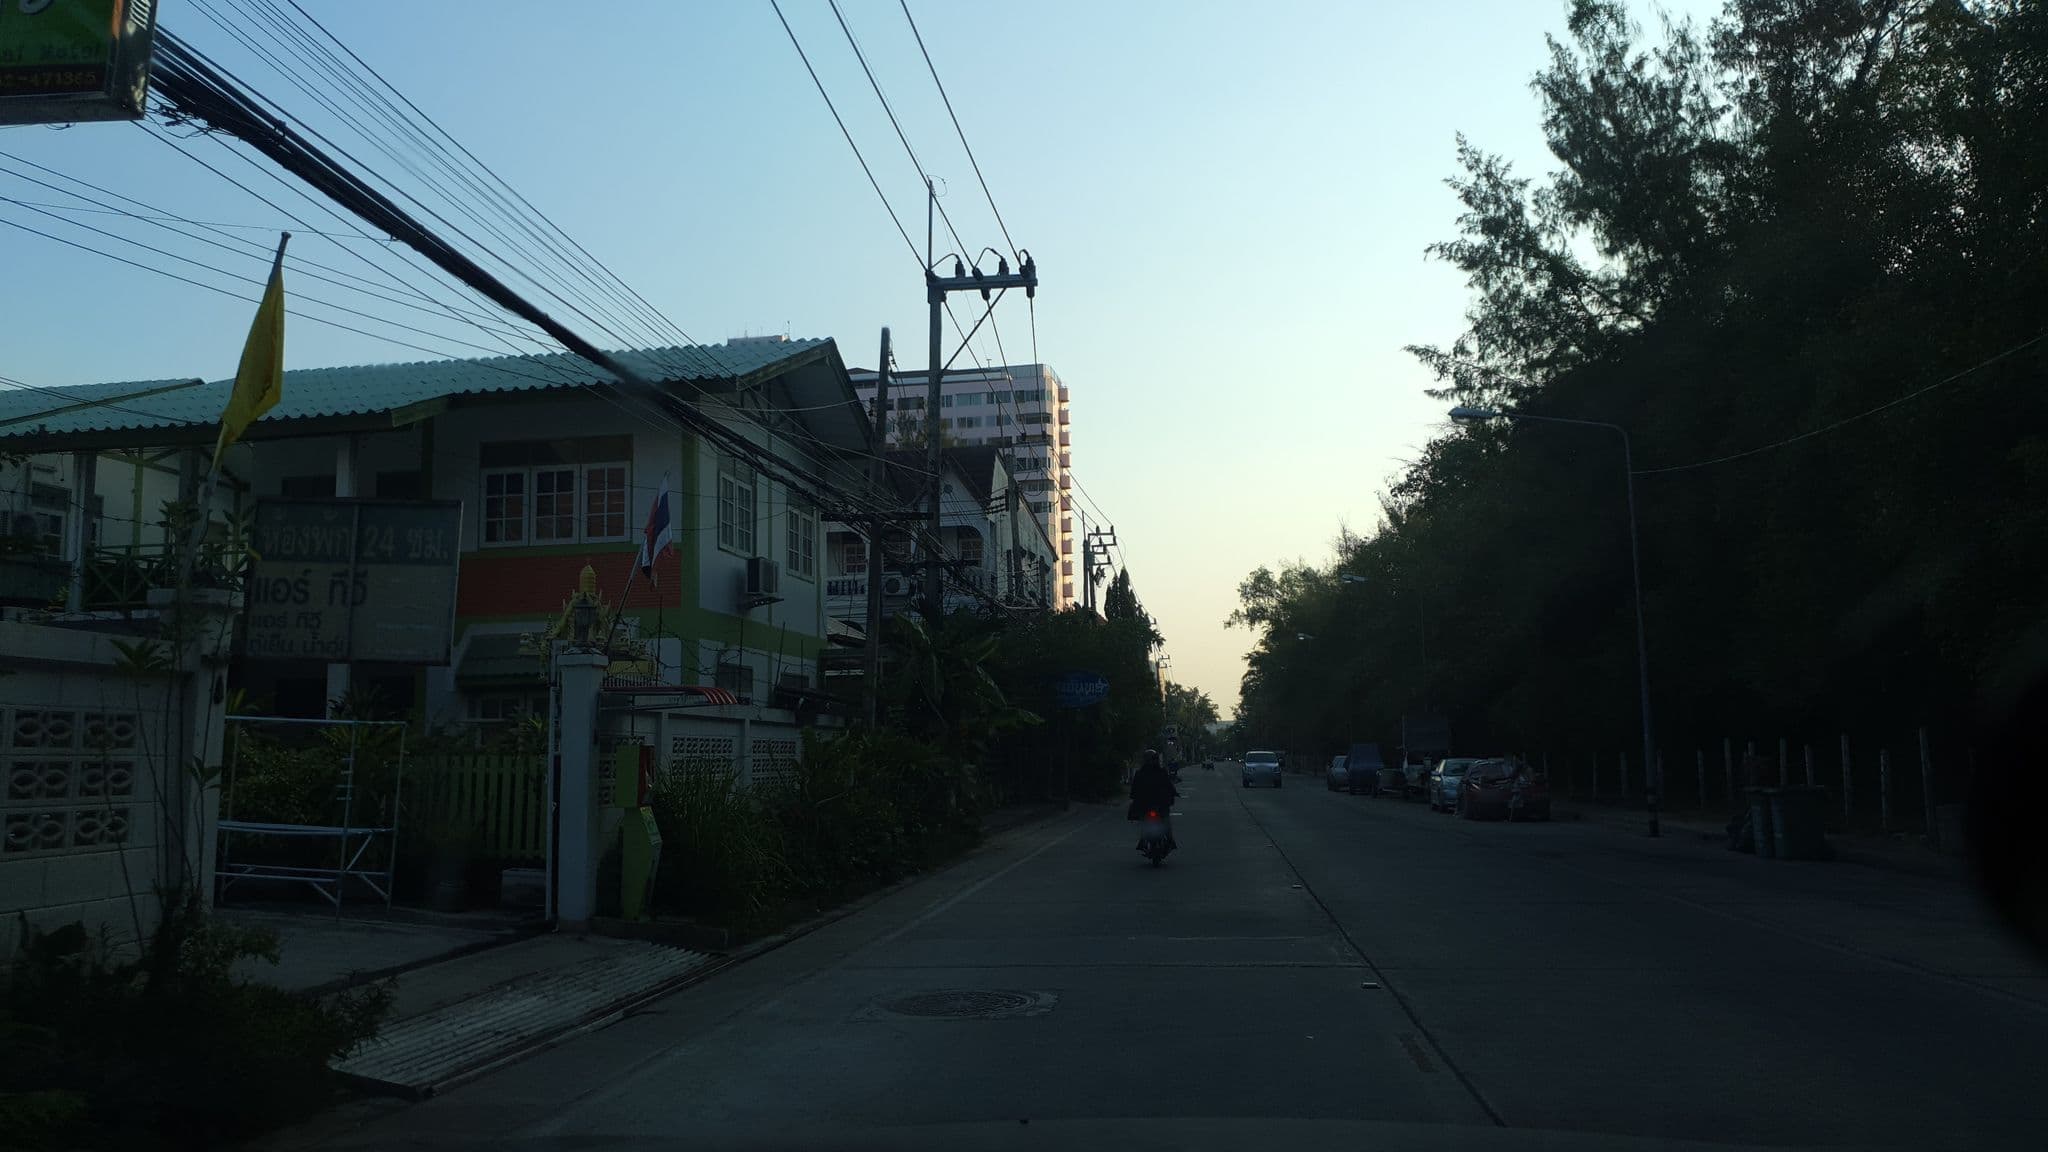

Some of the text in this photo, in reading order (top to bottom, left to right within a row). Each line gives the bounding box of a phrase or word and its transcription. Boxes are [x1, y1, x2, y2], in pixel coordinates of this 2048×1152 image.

[362, 525, 396, 558] 24
[254, 568, 368, 607] แอร์ ทีวี
